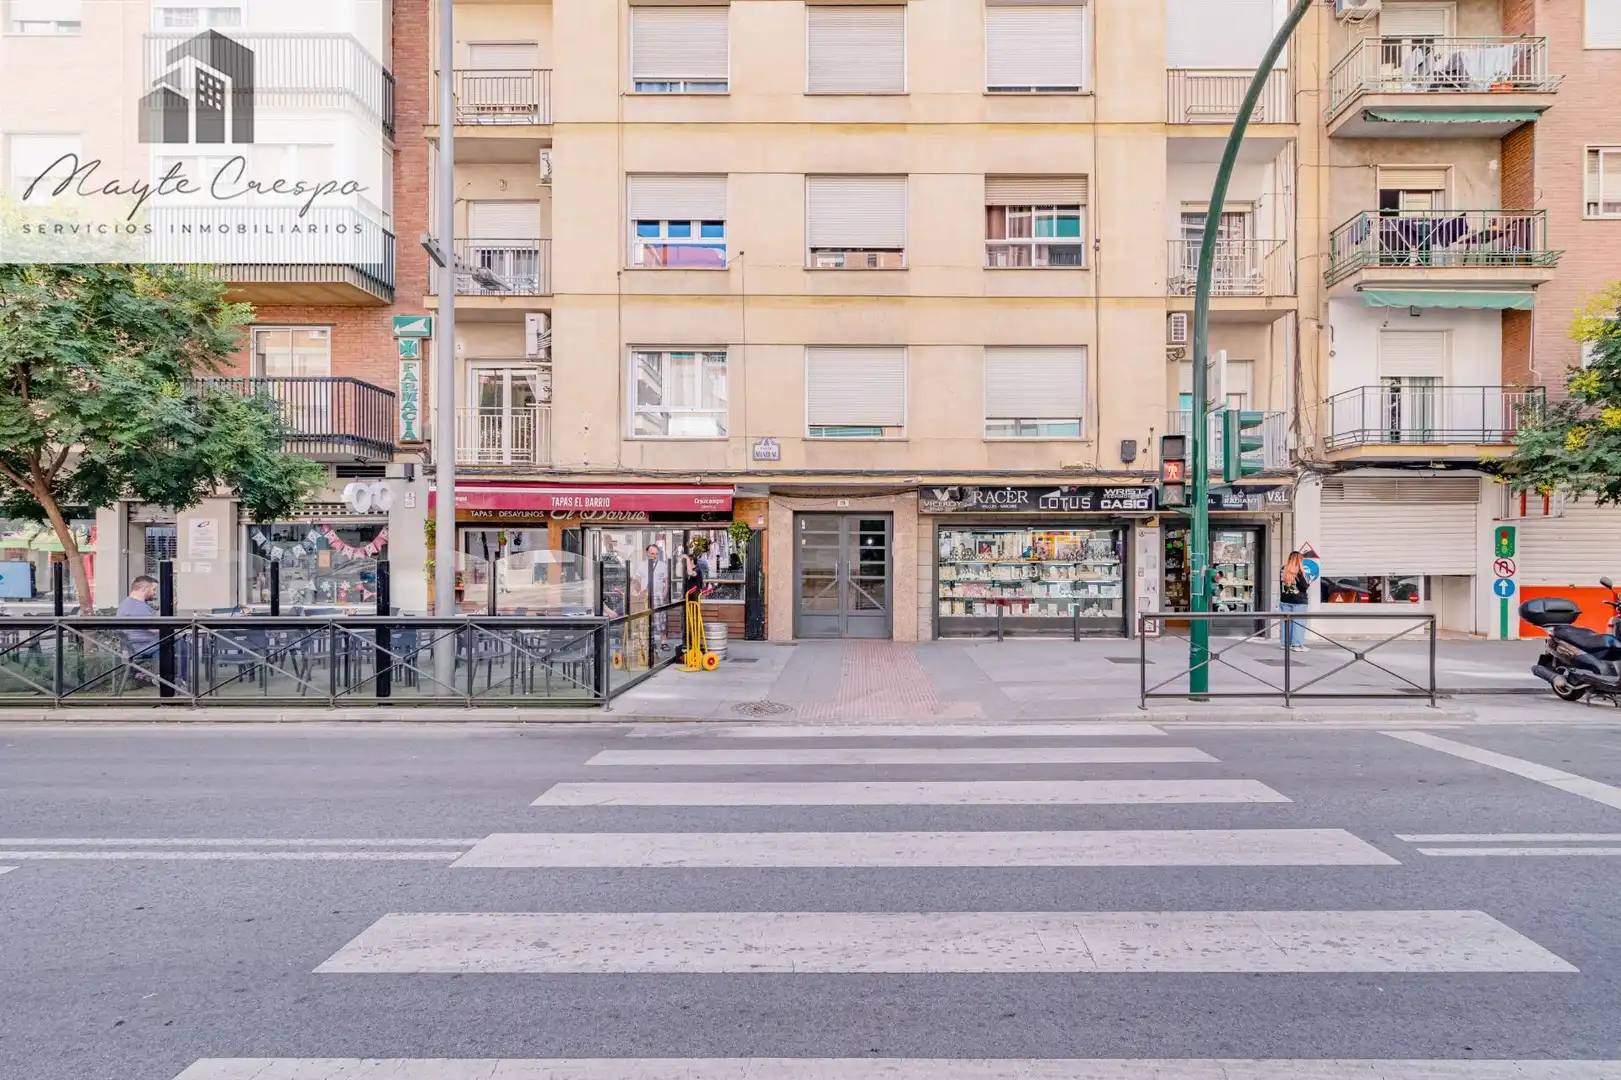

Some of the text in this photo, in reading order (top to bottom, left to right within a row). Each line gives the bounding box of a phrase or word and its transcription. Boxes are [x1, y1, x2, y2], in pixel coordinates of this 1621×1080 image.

[401, 363, 418, 440] FARMACIA
[972, 490, 1029, 504] RACER
[1267, 491, 1289, 502] V&L
[551, 497, 610, 508] TAPAS EL BARRIO
[1039, 497, 1091, 509] LOTUS
[1100, 500, 1149, 509] CASIO
[470, 510, 545, 518] TAPAS DESAYUNOS
